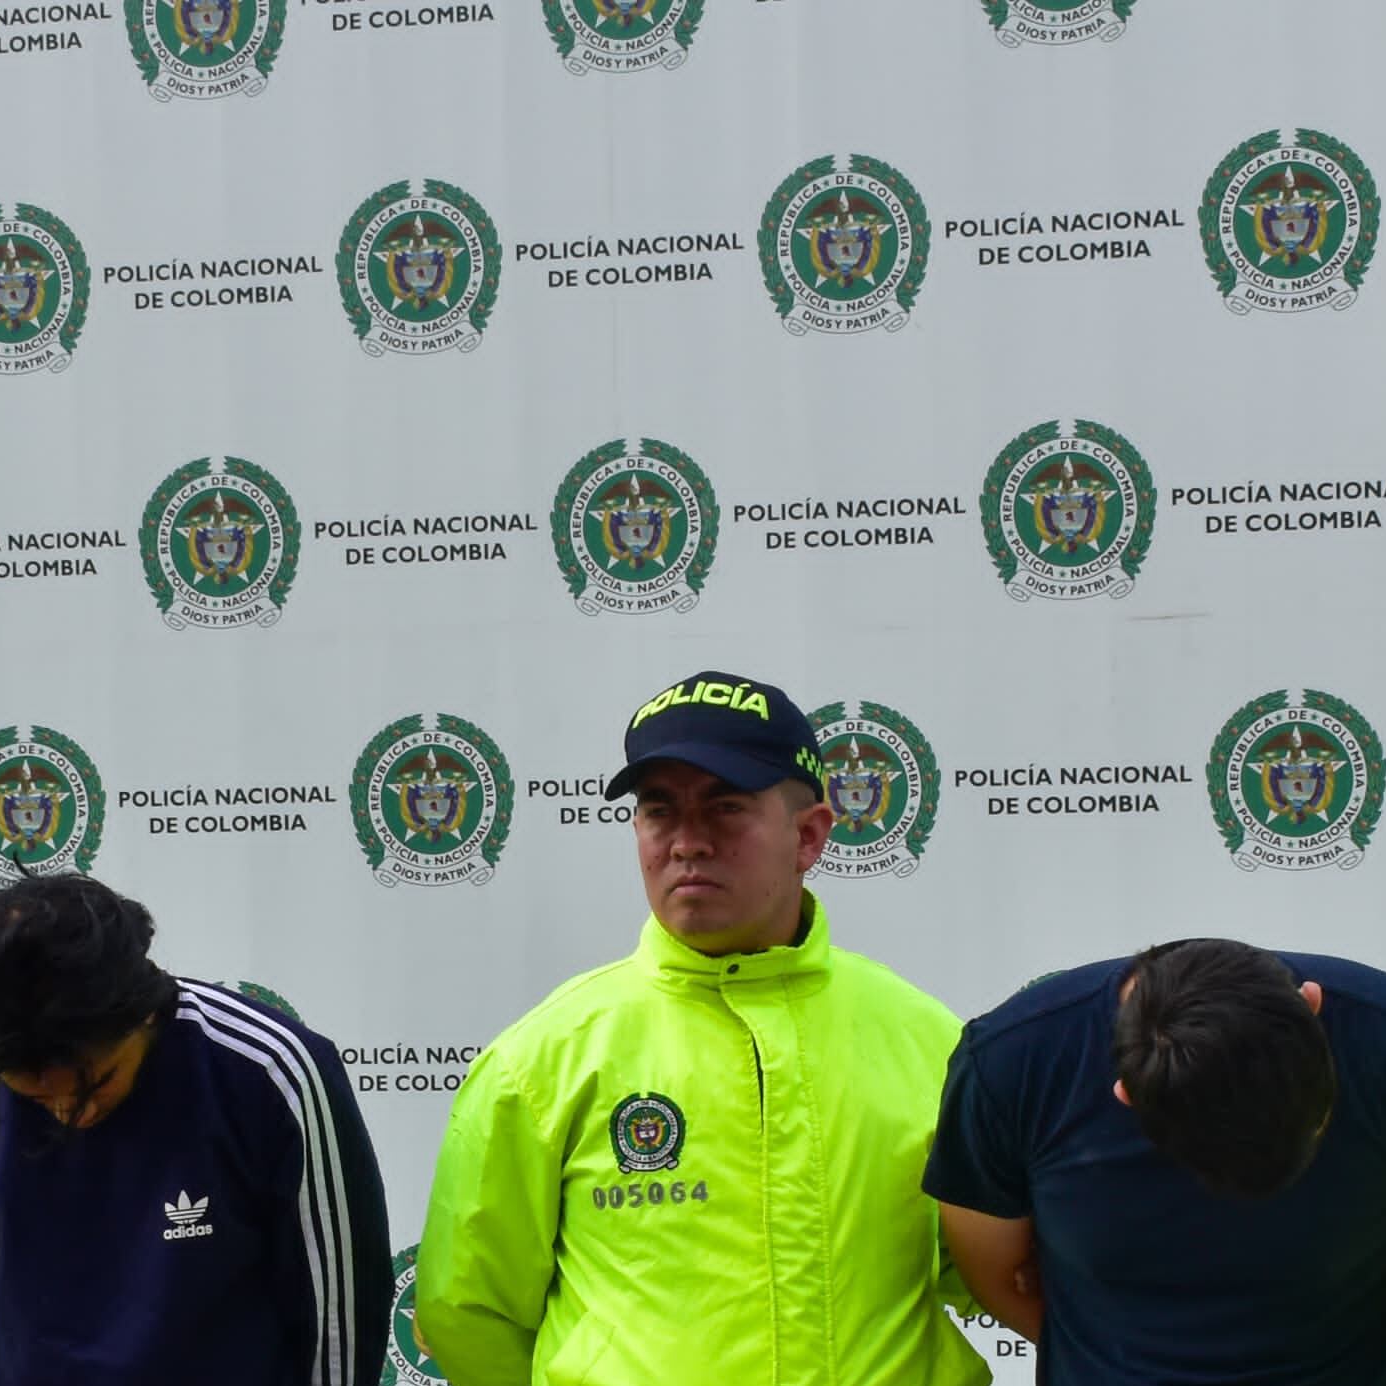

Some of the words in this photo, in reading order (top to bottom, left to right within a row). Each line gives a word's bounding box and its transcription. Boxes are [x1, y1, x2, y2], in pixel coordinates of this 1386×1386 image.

[332, 12, 362, 32] DE
[368, 3, 494, 29] COLOMBIA
[515, 235, 611, 262] POLICÍA
[617, 232, 745, 257] NACIONAL
[103, 258, 195, 284] POLICÍA
[200, 255, 324, 279] NACIONAL
[548, 269, 578, 288] DE
[585, 262, 713, 286] COLOMBIA
[134, 291, 164, 310] DE
[170, 284, 294, 308] COLOMBIA
[733, 497, 830, 523] POLICÍA
[836, 496, 967, 519] NACIONAL
[7, 529, 127, 552] NACIONAL
[766, 531, 797, 550] DE
[803, 526, 934, 548] COLOMBIA
[631, 681, 769, 729] POLICÍA
[1288, 709, 1308, 720] DE
[1322, 717, 1364, 789] COLOMBIA
[527, 773, 604, 797] POLICÍ
[954, 763, 1053, 788] POLICÍA
[1060, 764, 1193, 785] NACIONAL
[118, 784, 209, 809] POLICÍA
[214, 785, 337, 806] NACIONAL
[988, 797, 1020, 816] DE
[1026, 794, 1160, 815] COLOMBIA
[149, 816, 178, 834] DE
[184, 813, 307, 833] COLOMBIA
[560, 807, 590, 824] DE
[1298, 805, 1359, 849] NACIONAL
[1298, 845, 1345, 866] PATRIA
[341, 1042, 420, 1065] OLICÍA
[359, 1074, 389, 1092] DE
[592, 1180, 709, 1211] 005064
[163, 1224, 213, 1240] adidas
[996, 1340, 1028, 1357] DE
